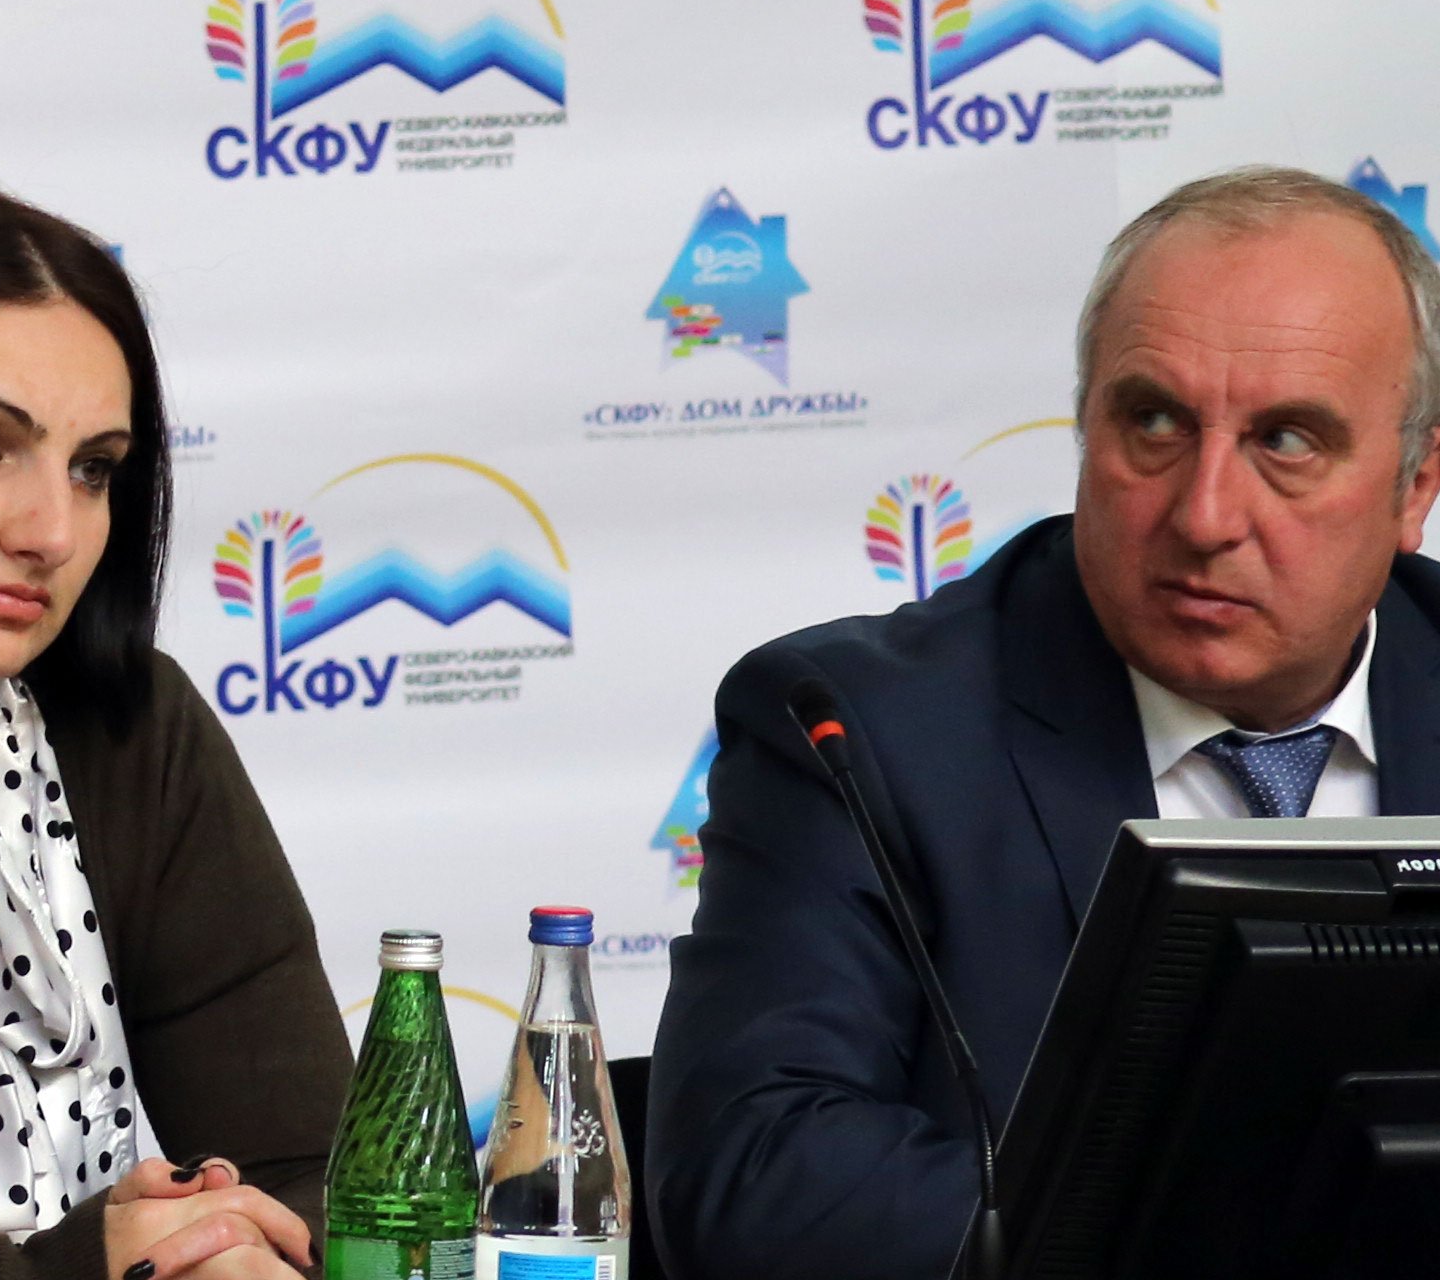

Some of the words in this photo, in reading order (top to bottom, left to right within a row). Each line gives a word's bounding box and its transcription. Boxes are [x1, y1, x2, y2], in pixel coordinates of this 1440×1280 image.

[204, 120, 392, 182] СКФУ
[866, 90, 1051, 151] СКФУ
[681, 397, 742, 423] ДОМ
[214, 653, 401, 718] СКФУ
